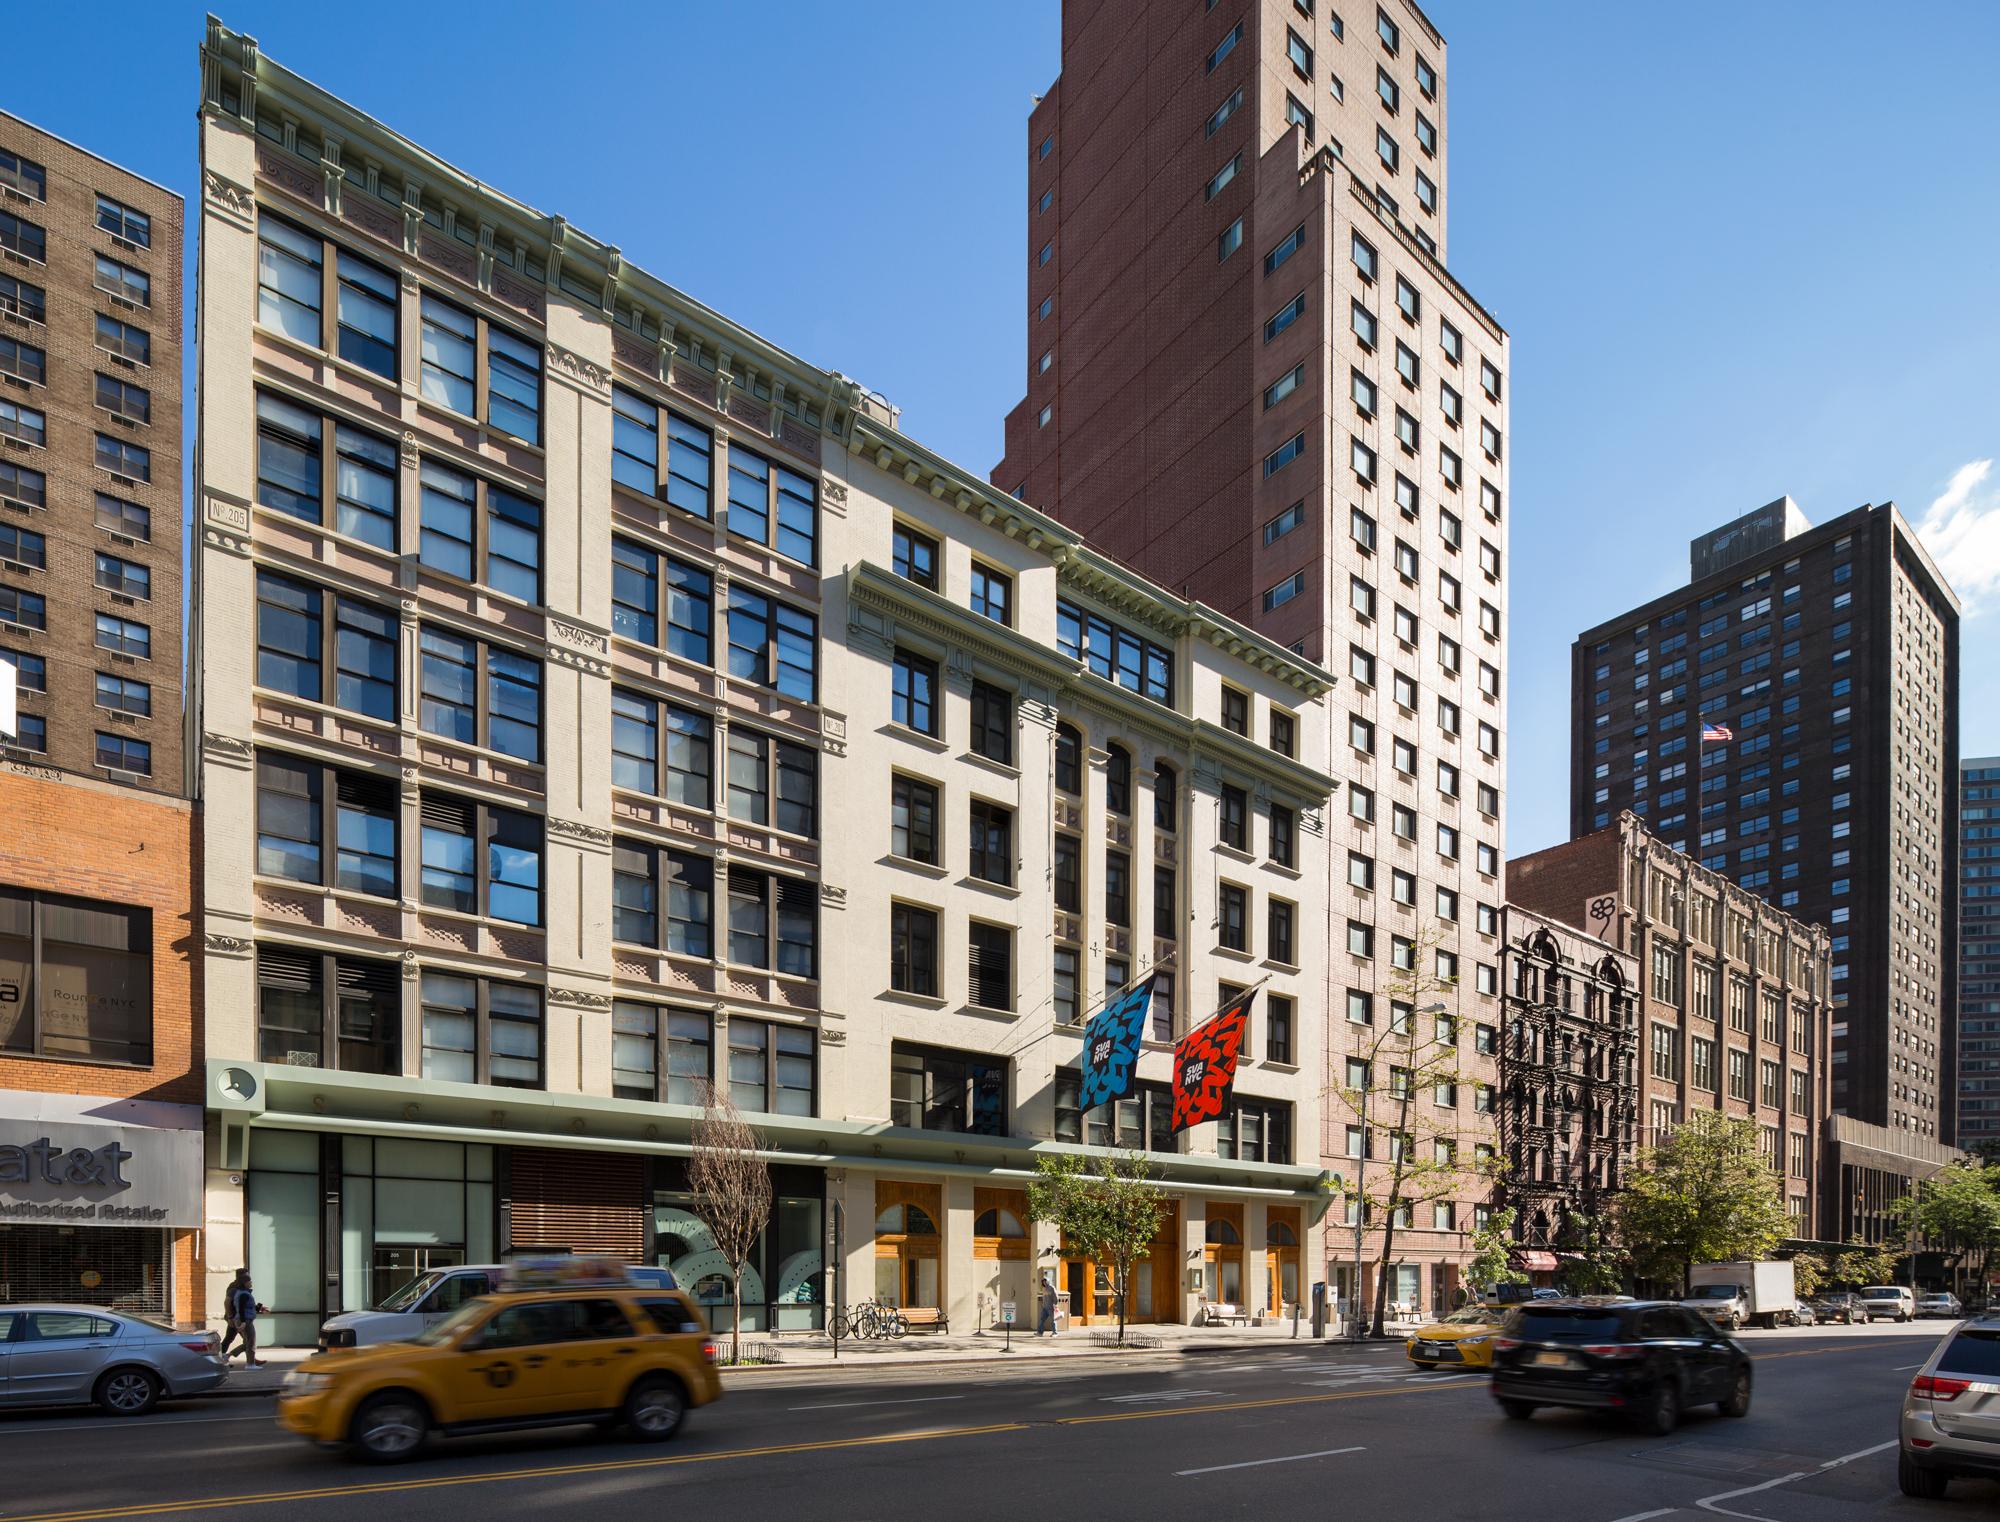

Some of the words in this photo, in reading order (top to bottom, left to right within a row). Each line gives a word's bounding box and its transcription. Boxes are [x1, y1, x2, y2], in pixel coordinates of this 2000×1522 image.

[1095, 1040, 1111, 1053] SVA
[1093, 1049, 1109, 1064] NYC
[1186, 1062, 1203, 1076] SVA
[1184, 1071, 1202, 1086] NYC
[0, 1137, 132, 1188] at&t
[104, 1204, 169, 1220] Retailer
